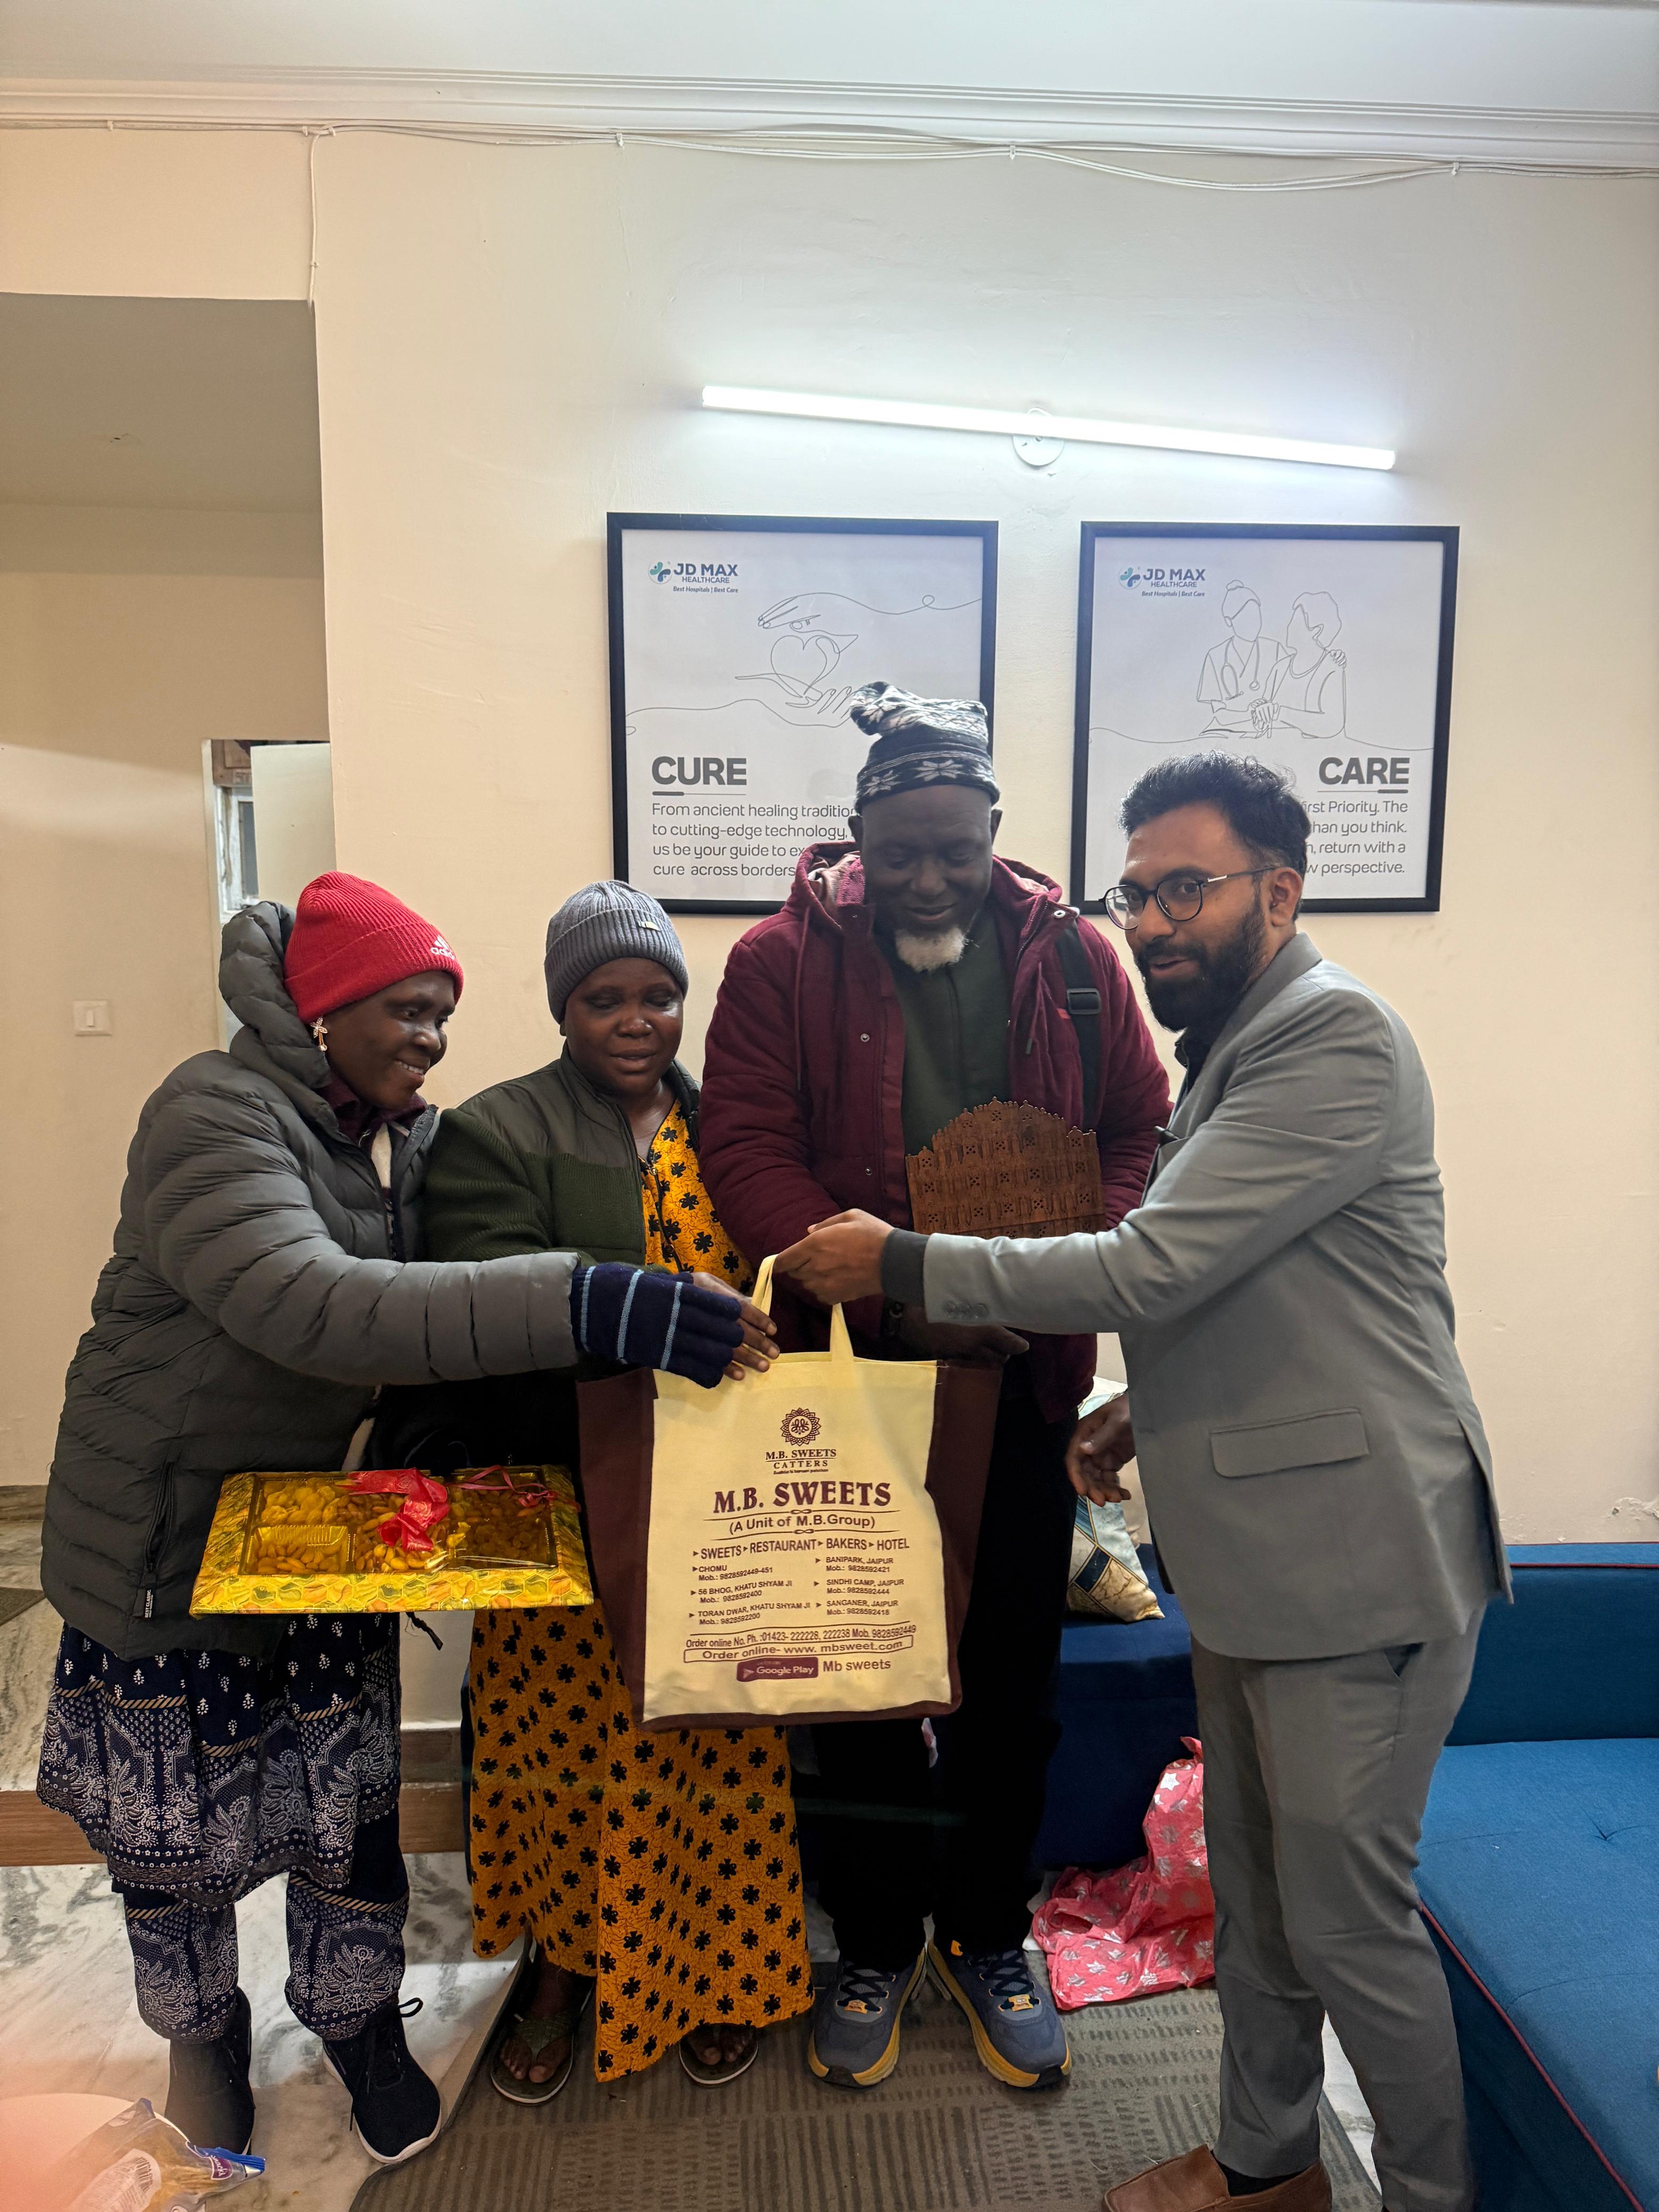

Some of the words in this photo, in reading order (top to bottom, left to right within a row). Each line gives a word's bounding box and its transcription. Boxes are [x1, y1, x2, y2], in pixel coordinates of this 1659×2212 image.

[674, 563, 696, 575] JD
[701, 564, 738, 576] MAX
[1143, 568, 1165, 581] JD
[1170, 568, 1205, 581] MAX
[652, 756, 747, 785] CURE
[1319, 757, 1410, 785] CARE
[652, 803, 690, 815] From
[693, 804, 745, 816] ancient
[749, 804, 798, 820] healing
[1328, 801, 1379, 816] Priority.
[1383, 800, 1408, 812] The
[652, 824, 666, 835] to
[671, 824, 761, 840] cutting-edge
[766, 824, 848, 840] technology,
[1313, 822, 1337, 833] han
[1341, 823, 1367, 836] you
[1371, 821, 1407, 833] think.
[653, 845, 669, 855] us
[673, 843, 691, 855] be
[694, 846, 727, 859] your
[730, 844, 768, 859] guide
[772, 845, 786, 856] to
[1319, 842, 1360, 853] return
[1364, 841, 1395, 853] with
[1398, 843, 1405, 853] a
[653, 866, 685, 875] cure
[691, 866, 738, 875] across
[741, 864, 795, 876] borders
[1321, 862, 1405, 876] perspective.
[766, 1451, 787, 1460] M.B.
[791, 1449, 836, 1458] SWEETS
[774, 1460, 828, 1469] CATTERS
[713, 1487, 764, 1513] M.B.
[773, 1481, 891, 1506] SWEETS
[729, 1521, 743, 1535] (A
[747, 1516, 773, 1530] Unit
[777, 1516, 792, 1527] of
[797, 1514, 875, 1529] M.B.Group)
[701, 1545, 742, 1559] SWEETS
[750, 1539, 817, 1553] RESTAURANT
[826, 1538, 867, 1550] BAKERS
[877, 1538, 909, 1550] HOTEL
[735, 1582, 757, 1591] KHATU
[726, 1607, 749, 1615] DWAR,
[734, 1637, 745, 1646] No.
[702, 1650, 739, 1659] Order
[742, 1646, 781, 1657] online-
[820, 1641, 902, 1652] mbsweet.com
[757, 1666, 791, 1675] Google
[793, 1666, 814, 1675] Play
[823, 1661, 842, 1672] Mb
[845, 1659, 891, 1670] sweets
